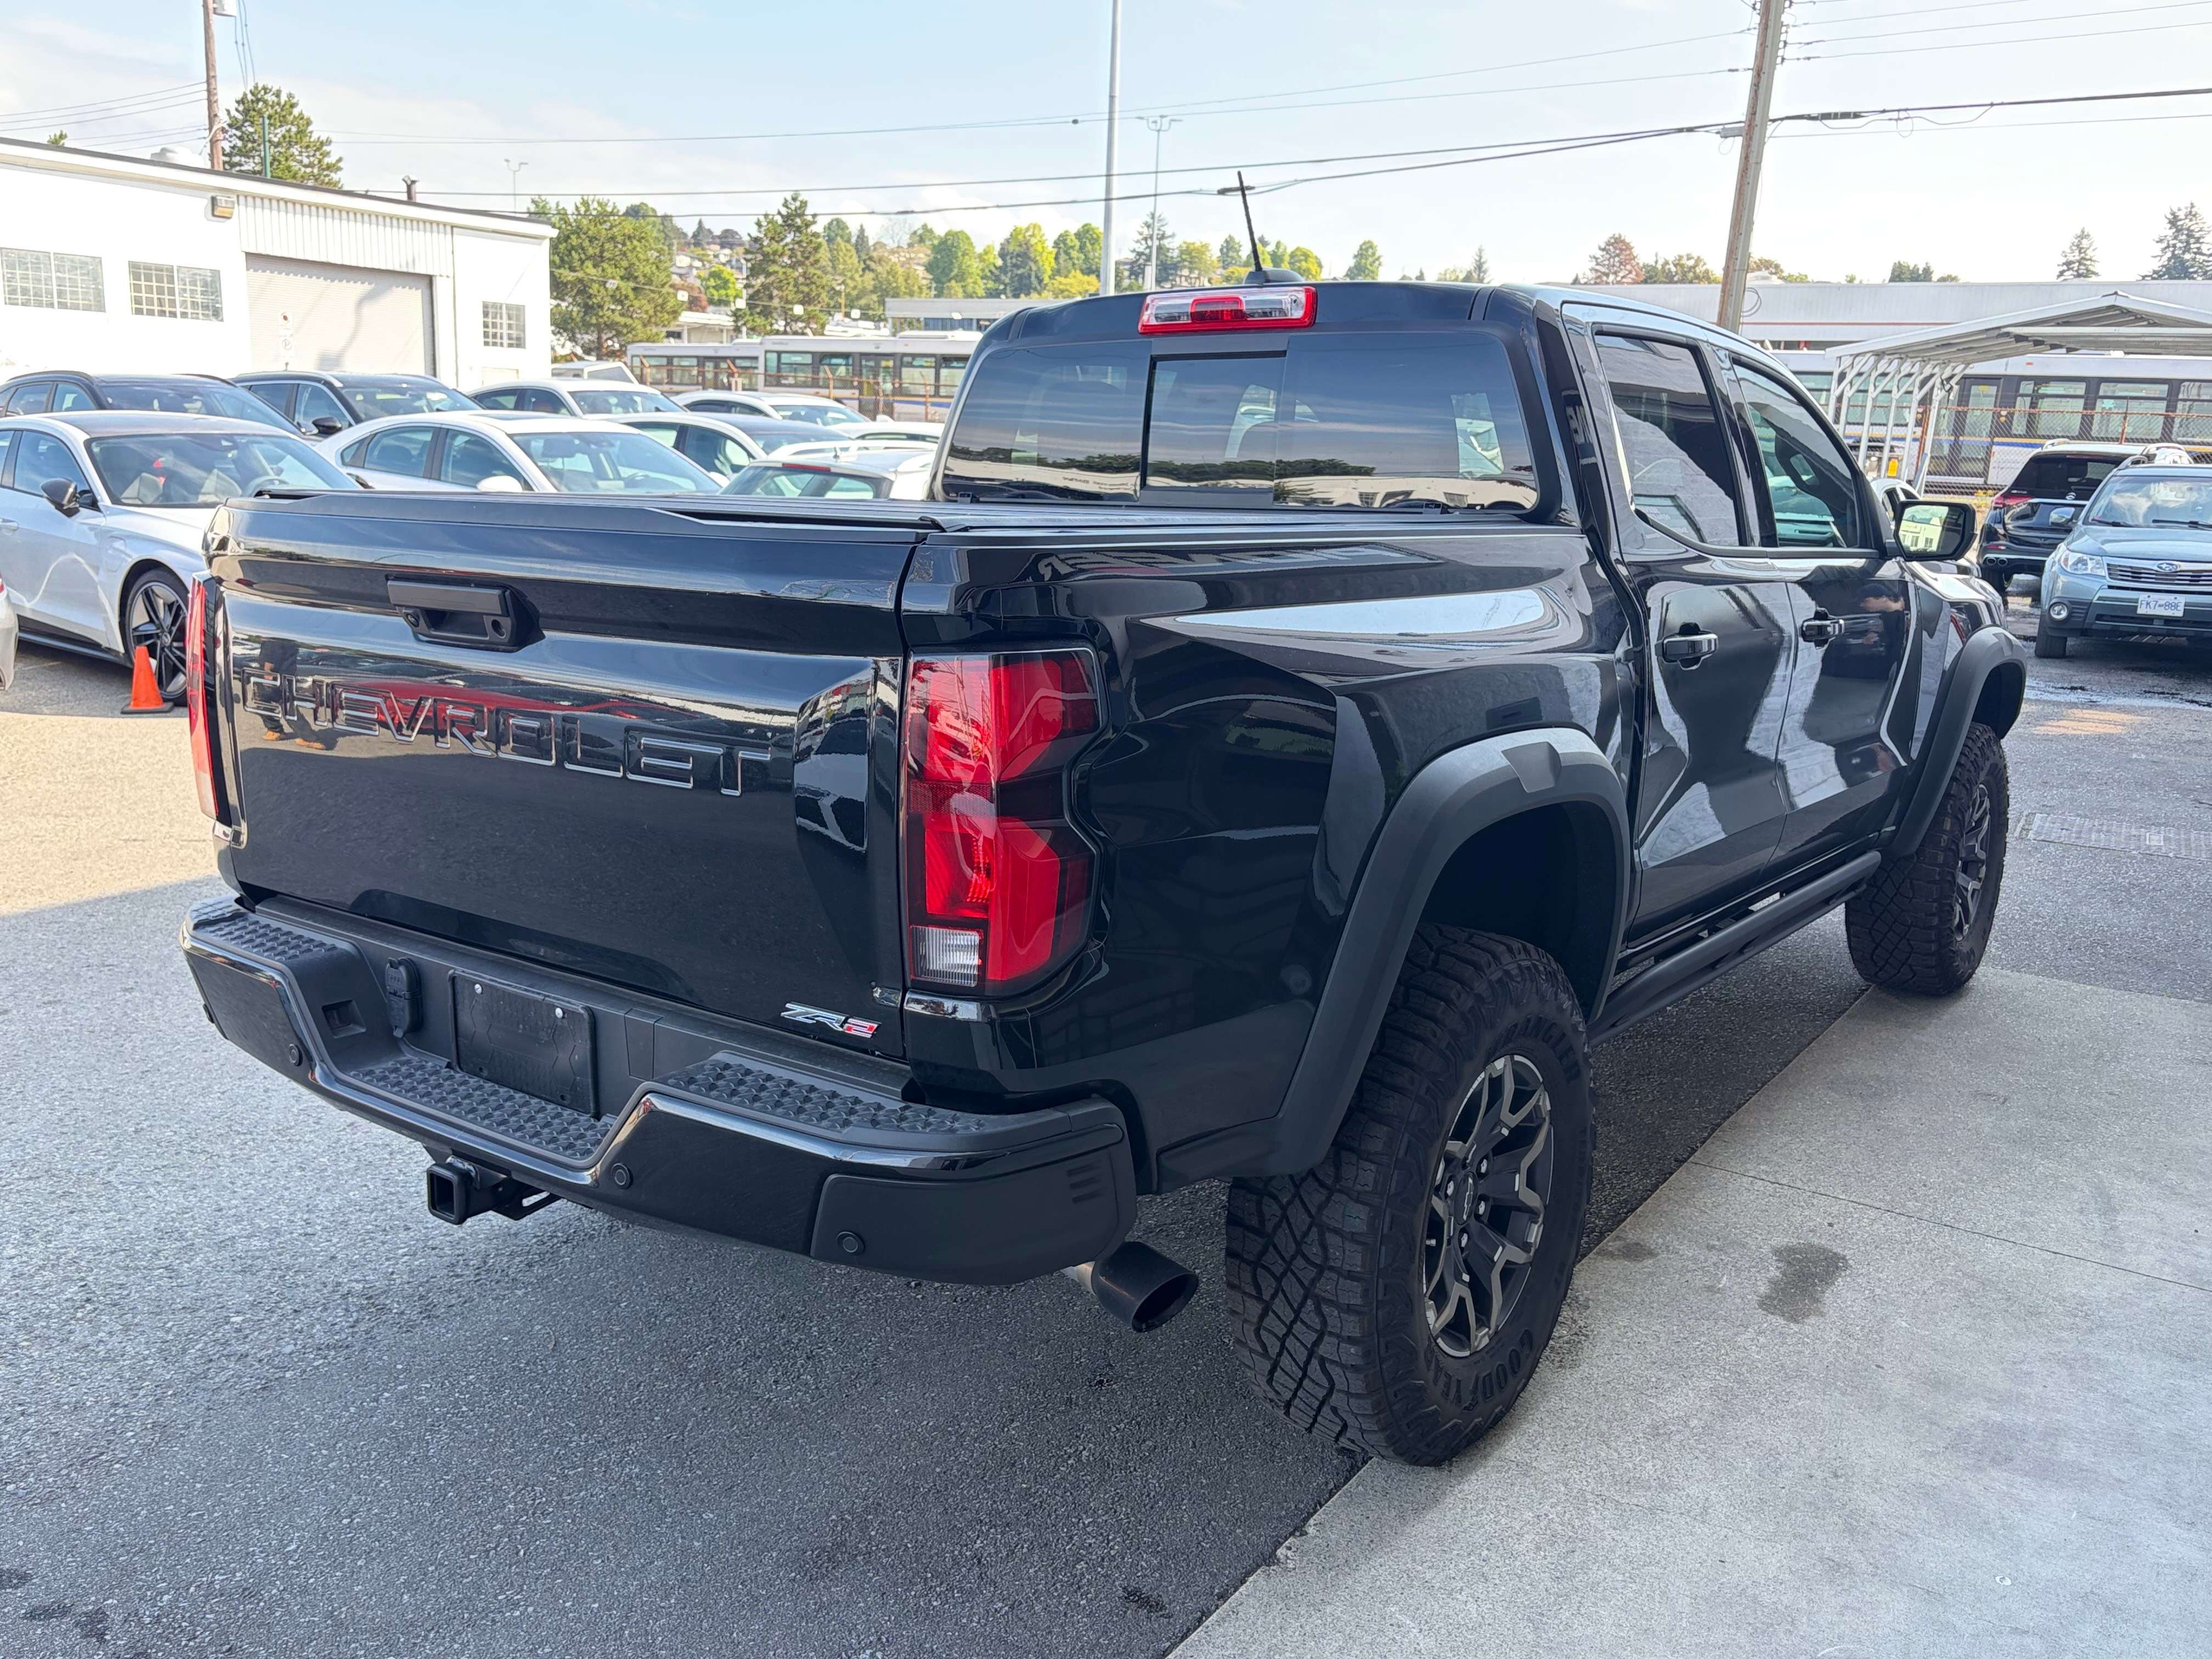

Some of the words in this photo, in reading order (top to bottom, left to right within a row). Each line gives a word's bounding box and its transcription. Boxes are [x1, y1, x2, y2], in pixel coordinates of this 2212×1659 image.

[2140, 600, 2159, 610] FK7
[241, 668, 772, 796] CHEVROLET
[780, 1001, 882, 1039] ZR2
